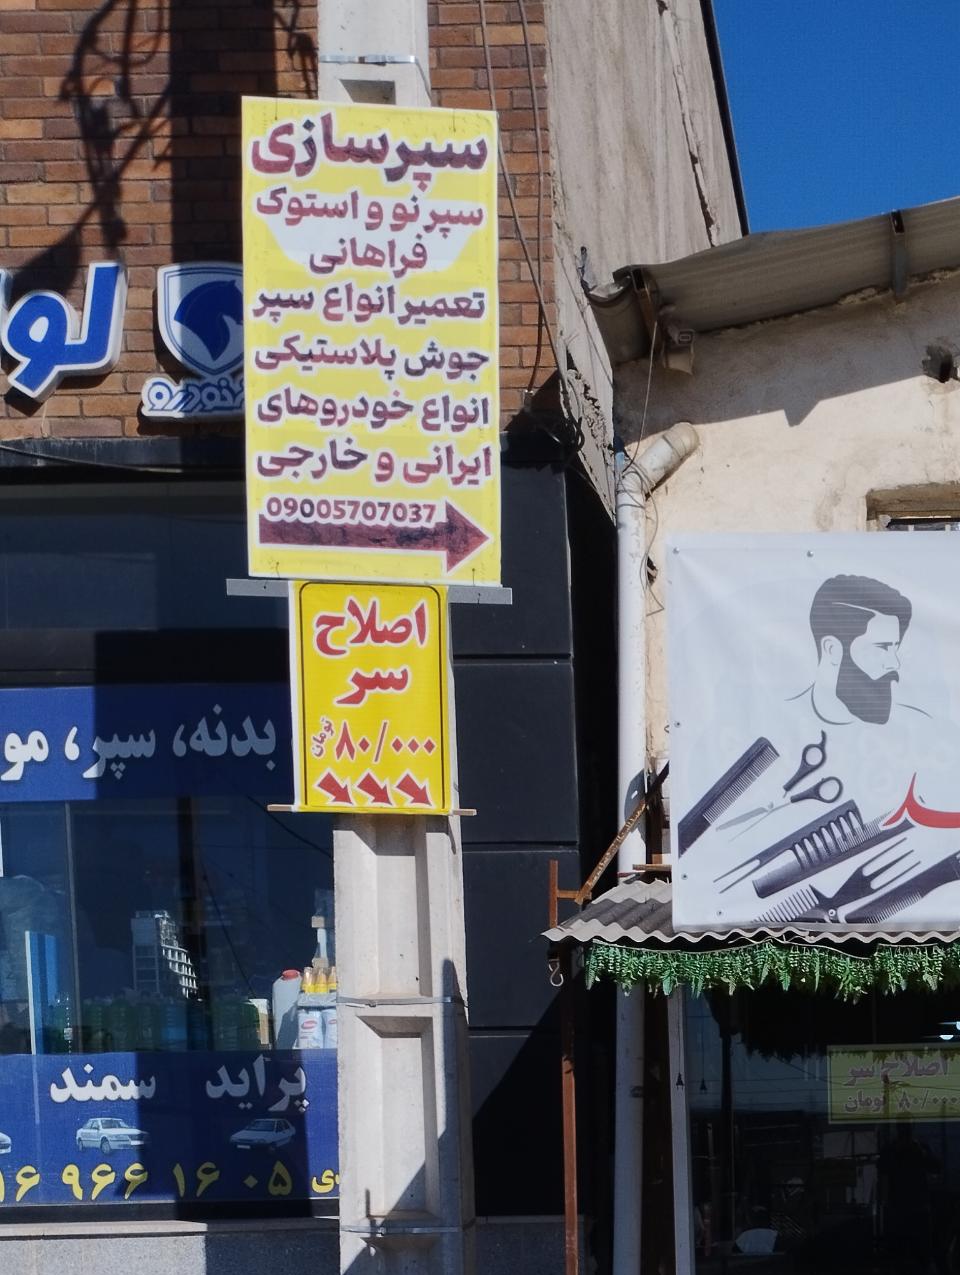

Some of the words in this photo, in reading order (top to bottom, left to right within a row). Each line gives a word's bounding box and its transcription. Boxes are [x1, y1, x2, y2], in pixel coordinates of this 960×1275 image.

[256, 186, 359, 226] استوک
[364, 200, 384, 231] و
[389, 194, 420, 232] نو
[422, 207, 484, 239] سپر
[309, 232, 428, 279] فراهانی
[252, 290, 315, 323] سپر
[322, 282, 395, 323] انواع
[397, 291, 486, 325] تعمیر
[254, 335, 397, 380] پلاستیکی
[403, 340, 490, 380] جوش
[257, 386, 414, 429] خودروهای
[421, 395, 489, 432] انواع
[256, 437, 369, 479] خارجی
[373, 451, 395, 482] و
[402, 444, 493, 486] ایرانی
[266, 496, 437, 523] 09005707037
[315, 598, 427, 656] اصلاح
[335, 667, 410, 706] سر
[310, 715, 335, 759] تومان
[334, 719, 437, 764] ۸۰/۰۰۰
[50, 1062, 157, 1104] سمند
[205, 1053, 311, 1113] پراید
